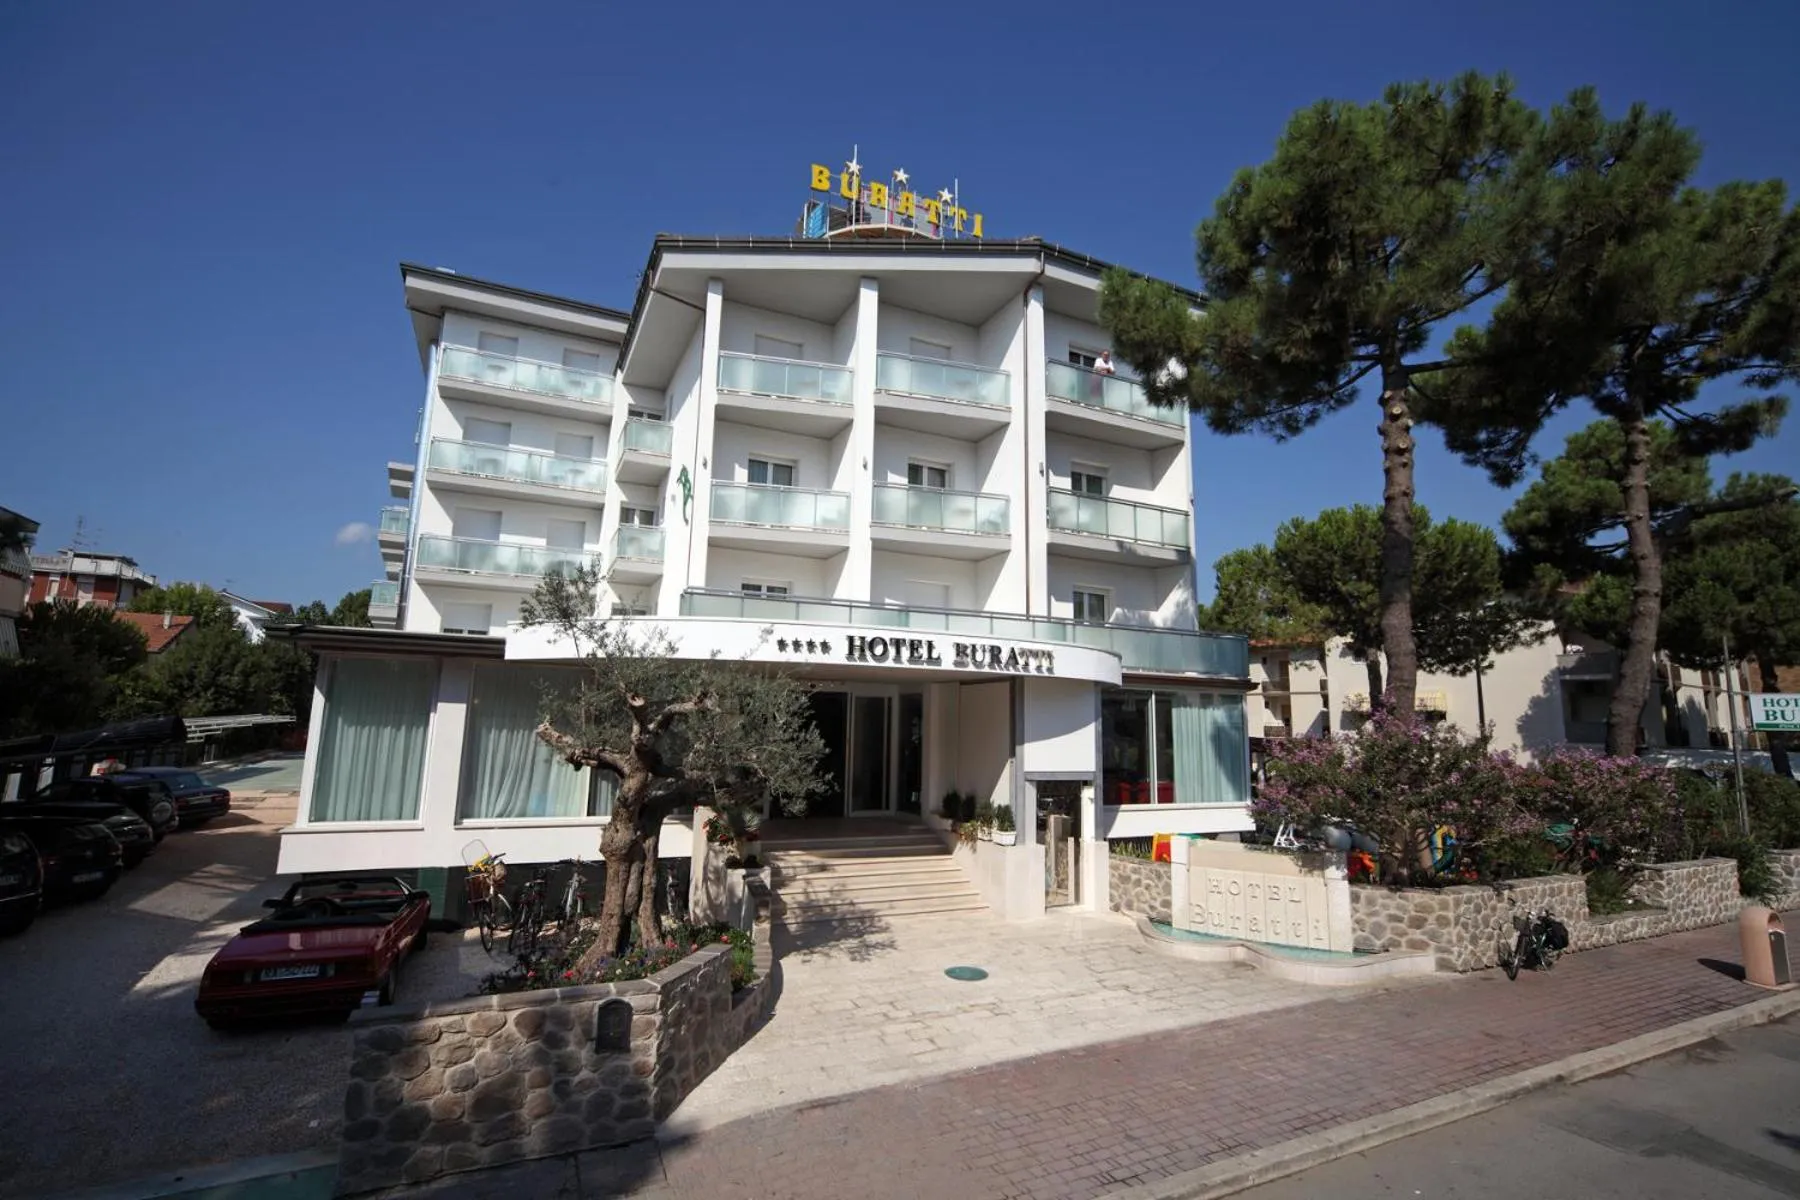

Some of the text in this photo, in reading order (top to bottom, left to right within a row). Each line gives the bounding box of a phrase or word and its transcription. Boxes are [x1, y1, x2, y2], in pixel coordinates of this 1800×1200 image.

[810, 163, 984, 238] BURATTI
[846, 634, 1056, 675] HOTEL BURATTI
[1207, 877, 1302, 903] HOTEL
[1188, 902, 1324, 941] Buratti
